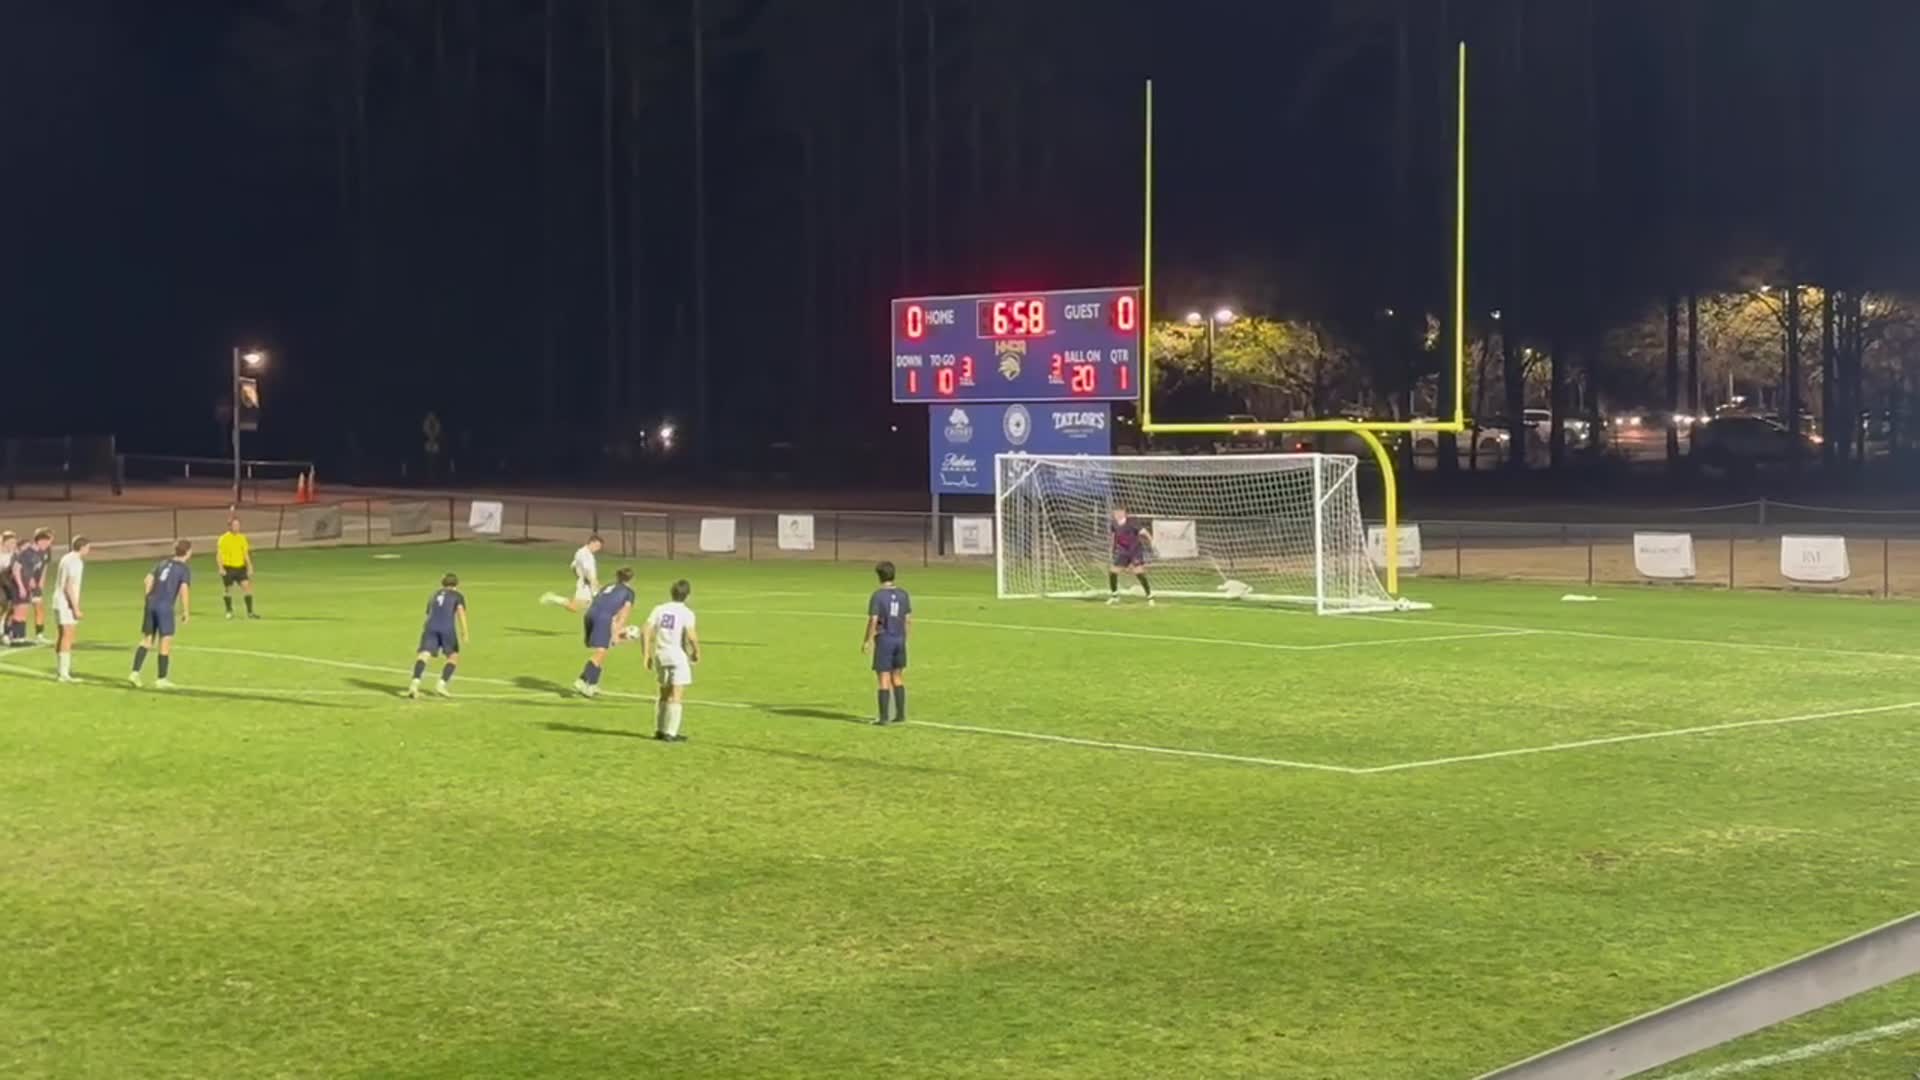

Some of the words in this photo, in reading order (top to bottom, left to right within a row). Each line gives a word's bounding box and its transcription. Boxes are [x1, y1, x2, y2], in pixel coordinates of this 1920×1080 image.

[907, 305, 922, 338] 0
[925, 309, 955, 325] HOME
[993, 300, 1044, 334] 6:58
[1064, 302, 1101, 320] GUEST
[1118, 296, 1134, 330] 0
[896, 355, 923, 368] DOWN
[930, 354, 942, 366] TO
[943, 354, 956, 366] GO
[961, 356, 973, 377] 3
[1051, 354, 1062, 375] 3
[1064, 351, 1085, 363] BALL
[1086, 350, 1101, 362] ON
[1110, 349, 1129, 363] QTR
[909, 370, 916, 393] 1
[938, 368, 954, 394] 10
[1072, 364, 1095, 392] 20
[1120, 366, 1127, 390] 1
